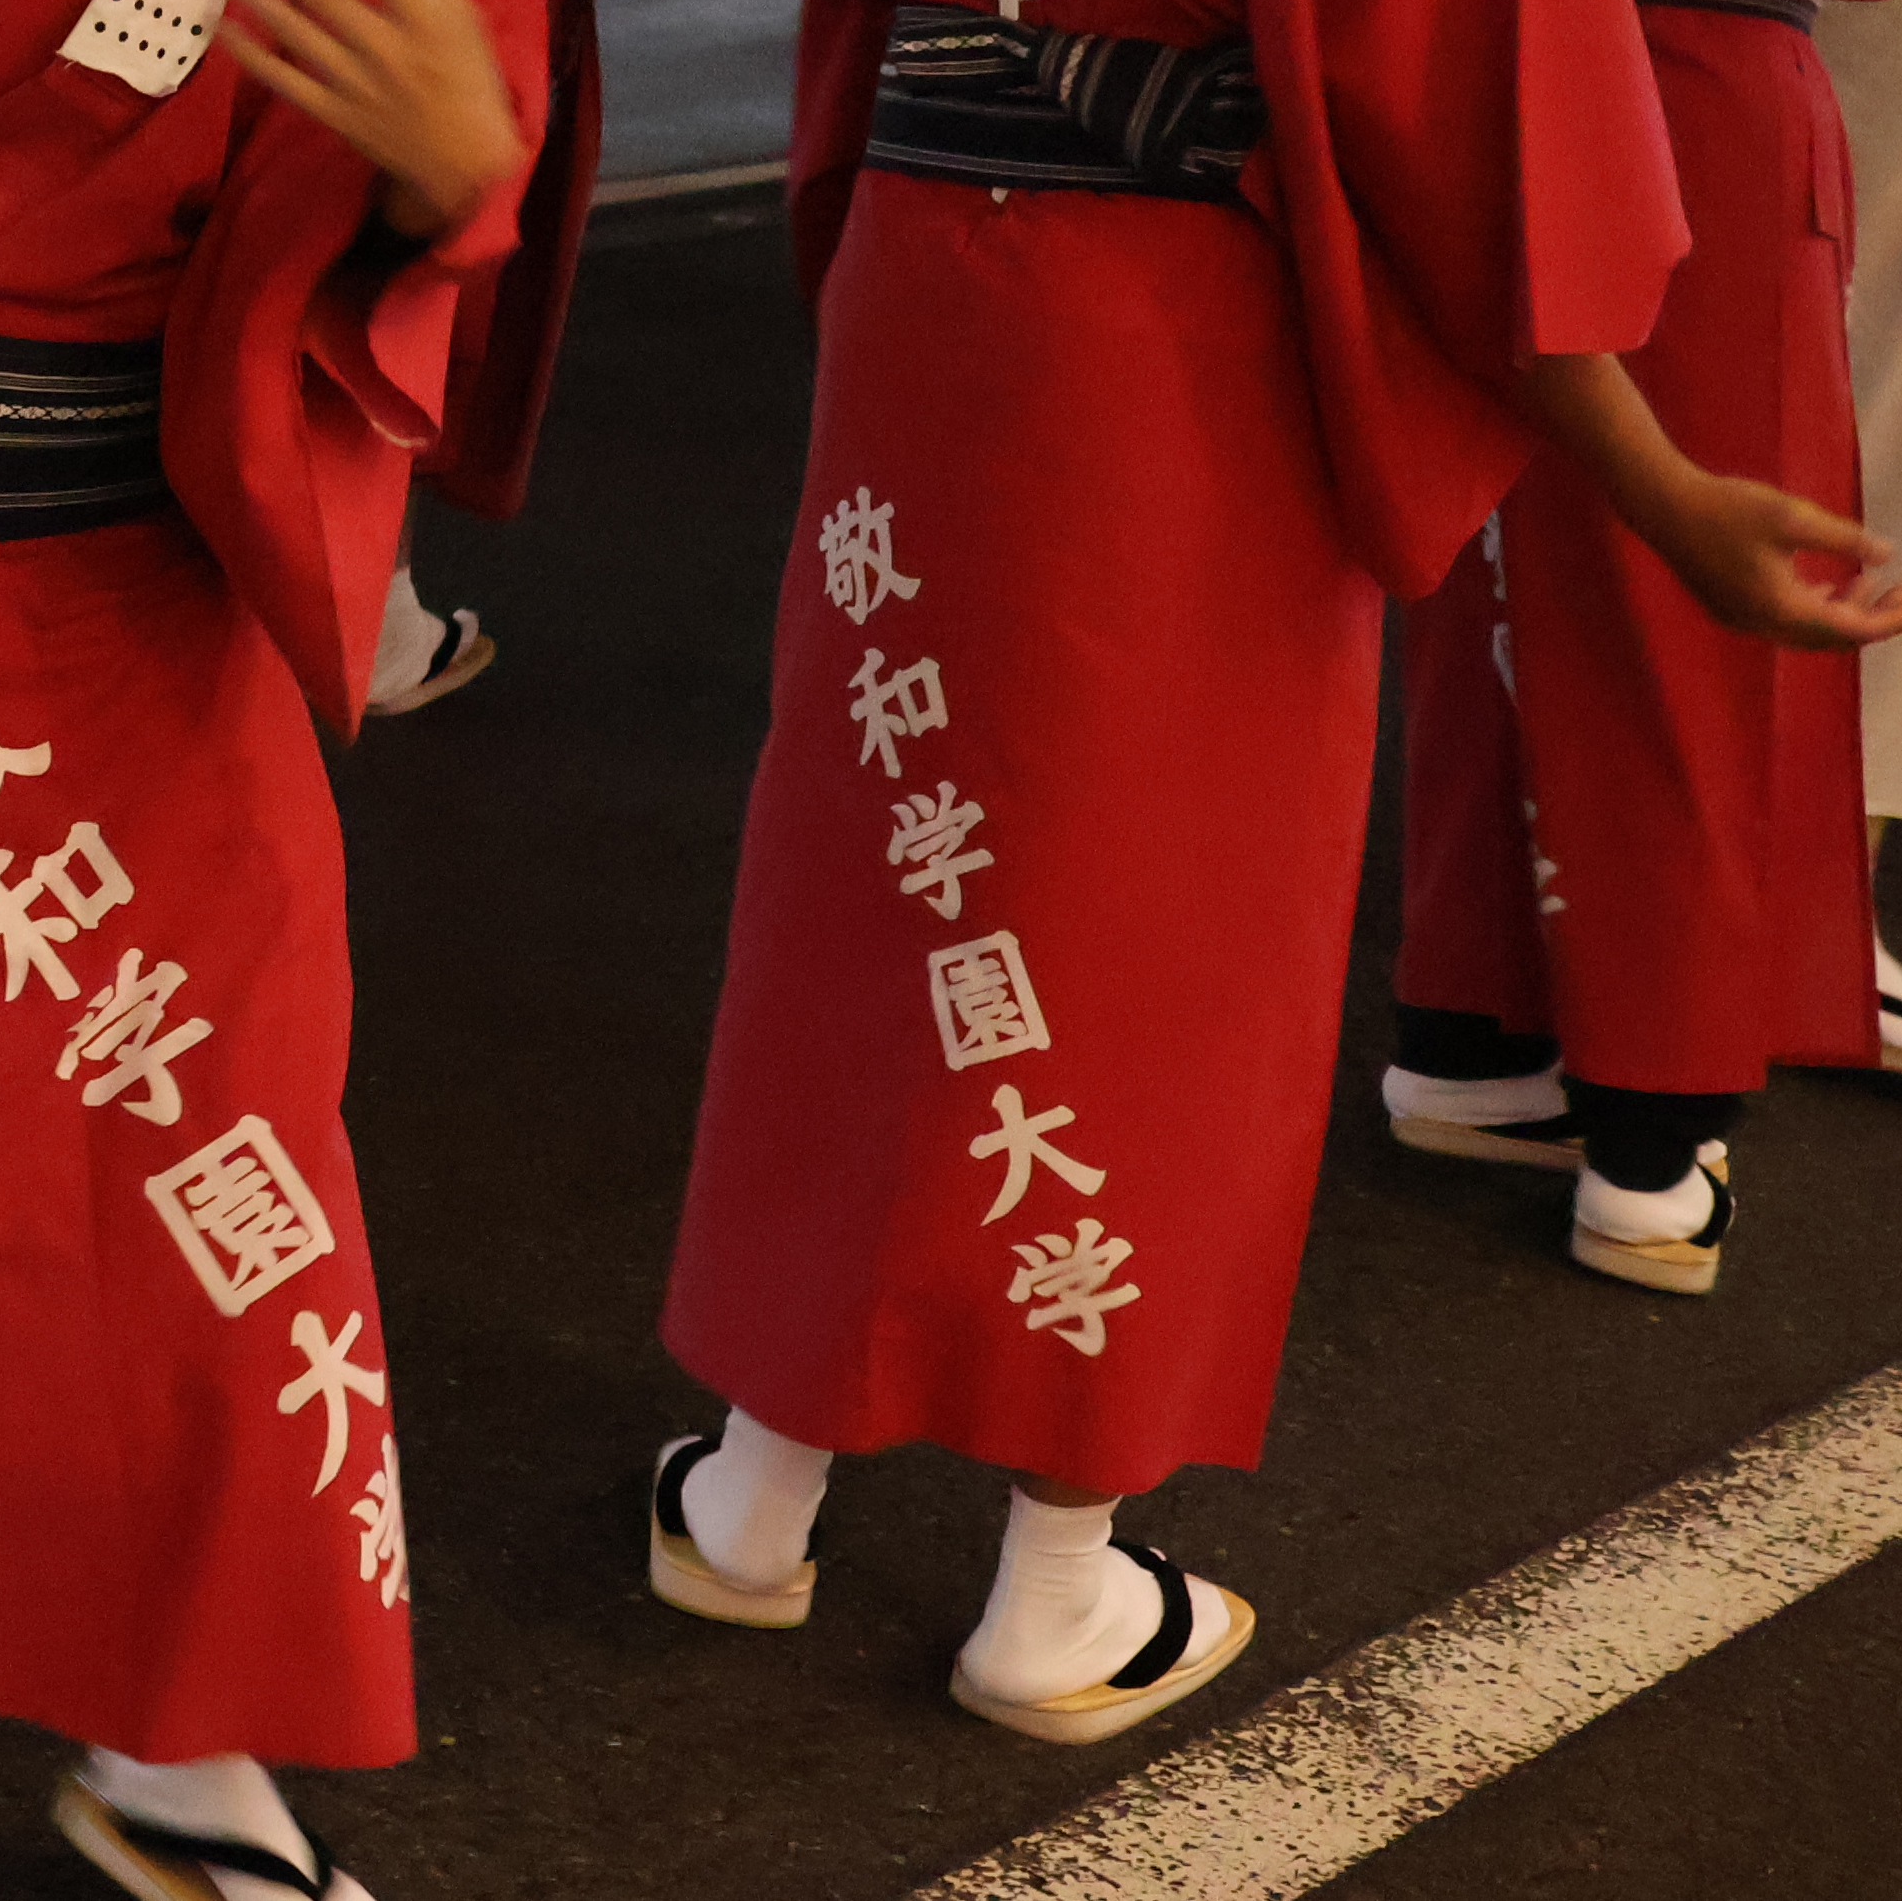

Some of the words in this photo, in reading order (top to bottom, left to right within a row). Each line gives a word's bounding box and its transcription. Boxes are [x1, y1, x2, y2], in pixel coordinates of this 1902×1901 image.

[818, 486, 1142, 1357] 敬和学園大学
